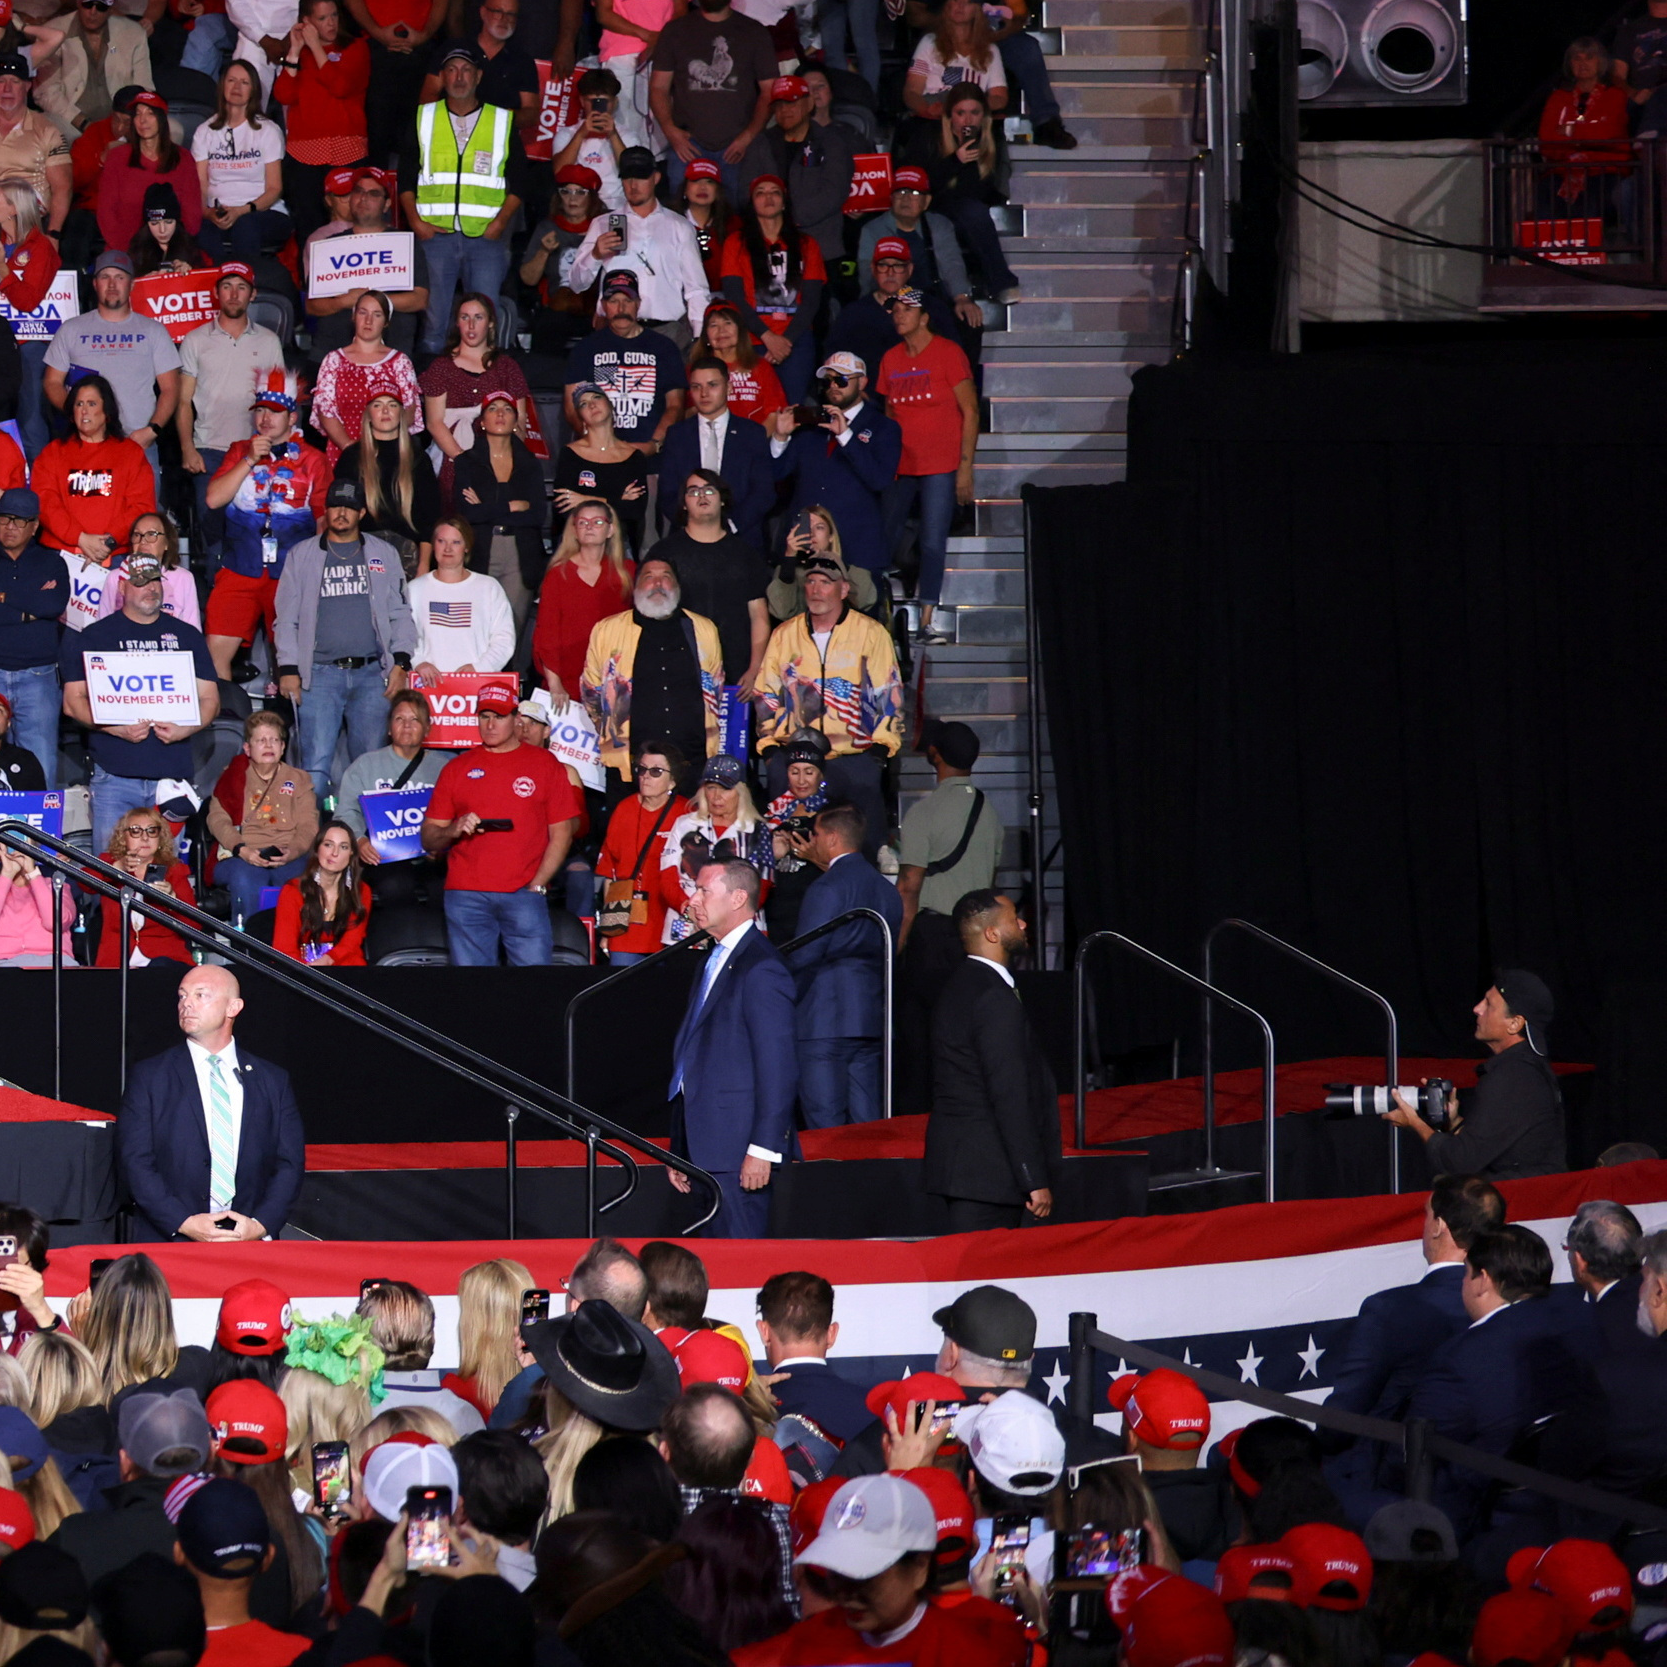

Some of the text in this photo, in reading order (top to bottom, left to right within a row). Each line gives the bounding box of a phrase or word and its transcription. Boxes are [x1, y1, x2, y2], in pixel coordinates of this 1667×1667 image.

[536, 80, 563, 143] VOTE
[330, 250, 394, 270] VOTE
[317, 264, 408, 282] NOVEMBER 5TH
[146, 290, 214, 315] VOTE
[79, 334, 146, 344] TRUMP
[593, 351, 657, 366] GOD, GUNS
[126, 639, 157, 650] STAND
[160, 639, 180, 650] FOR
[107, 674, 175, 693] VOTE
[97, 693, 191, 705] NOVEMBER 5TH
[429, 694, 479, 716] VOT
[236, 1321, 268, 1331] TRUMP
[231, 1421, 261, 1432] TRUMP
[1169, 1418, 1204, 1429] TRUMP
[1324, 1558, 1360, 1574] TRUMP
